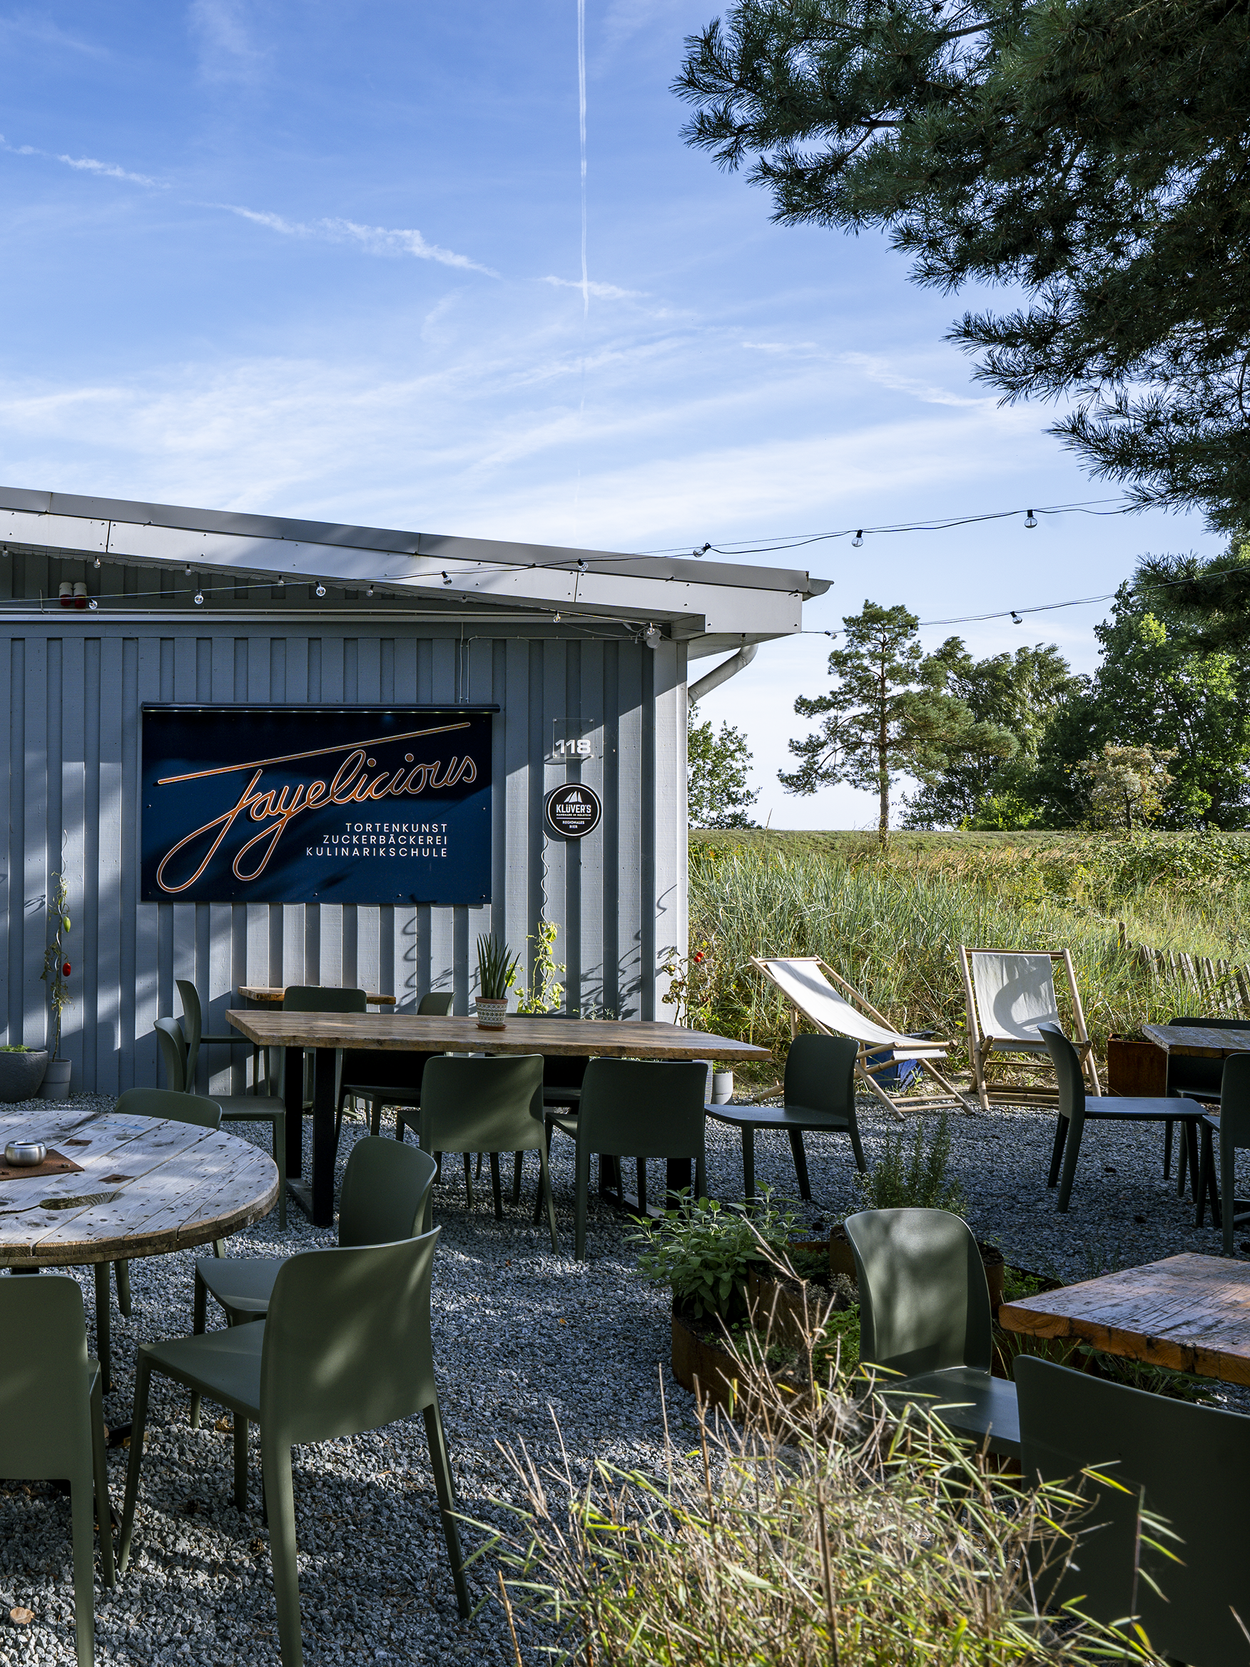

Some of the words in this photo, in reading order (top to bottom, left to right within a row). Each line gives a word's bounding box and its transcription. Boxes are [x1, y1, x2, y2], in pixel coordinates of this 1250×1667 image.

[555, 739, 591, 754] 118
[156, 722, 477, 893] Jayelicious
[555, 804, 592, 814] KLÜVER'S
[345, 822, 448, 833] TORTENKUNST
[322, 834, 448, 845] ZUCKERBÄCKEREI
[306, 847, 448, 858] KULINARIKSCHULE
